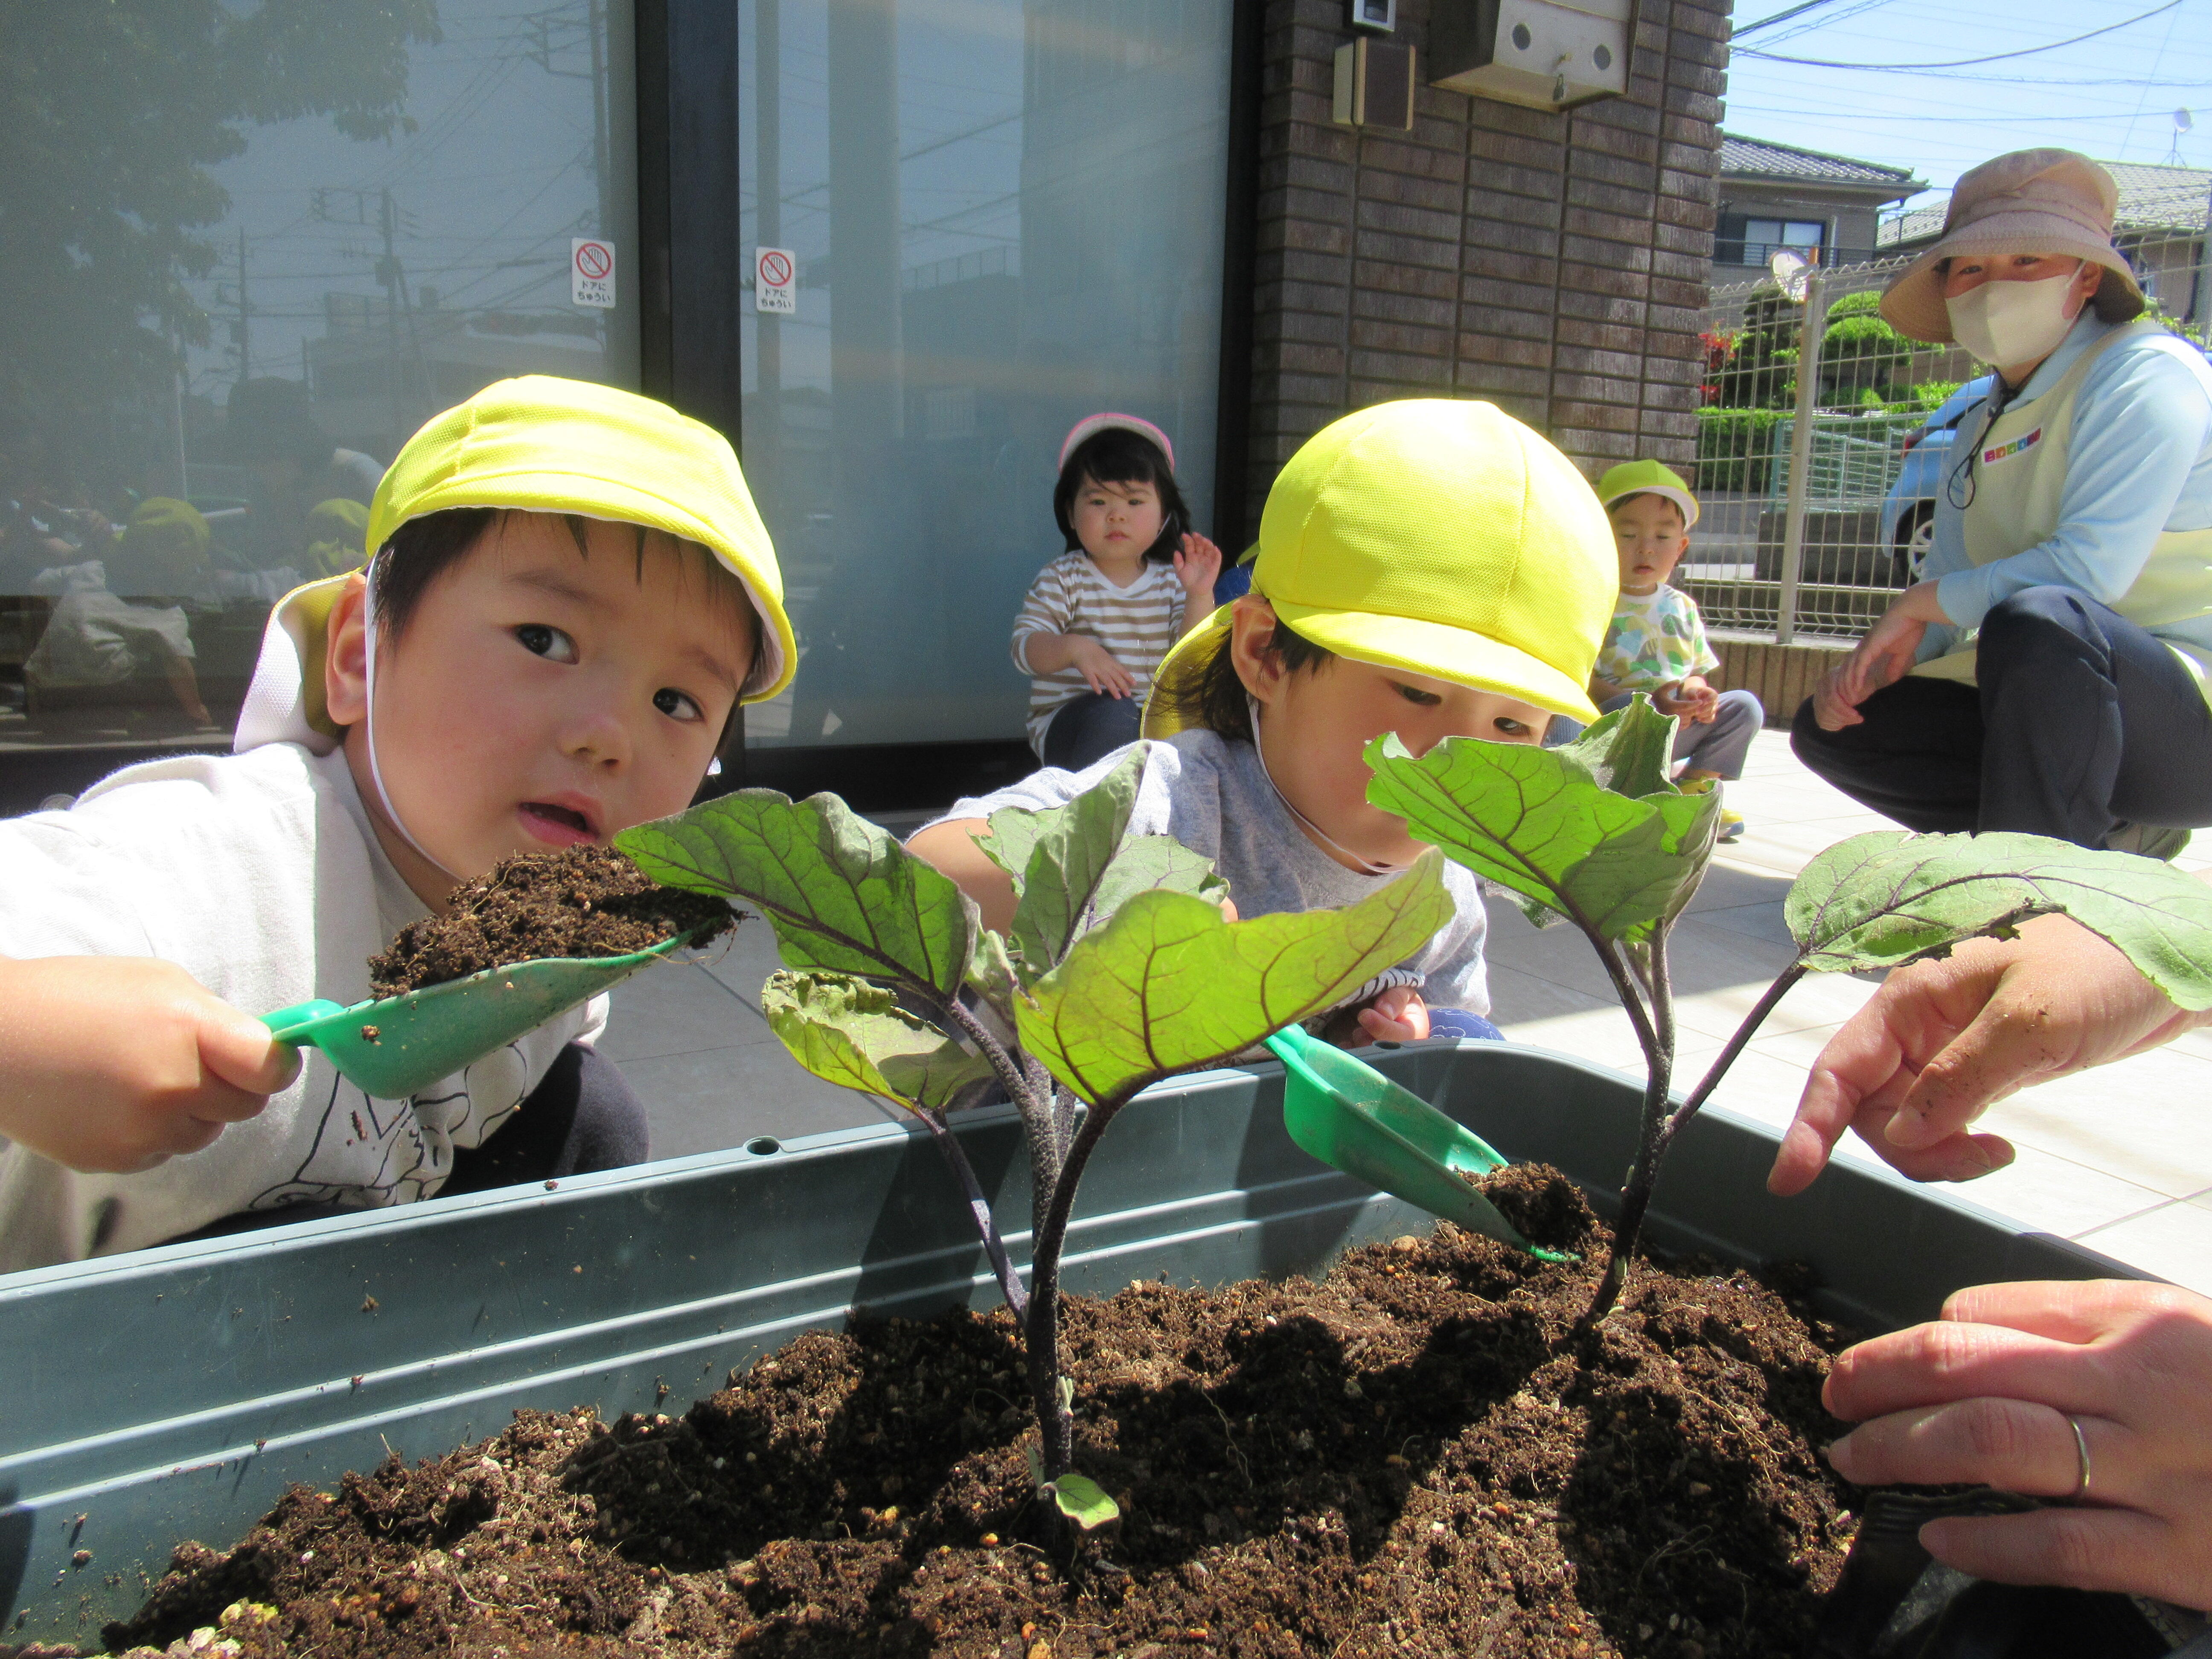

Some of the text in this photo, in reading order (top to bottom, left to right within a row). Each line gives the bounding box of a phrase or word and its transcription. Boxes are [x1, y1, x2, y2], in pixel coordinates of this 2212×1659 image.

[582, 280, 606, 291] ドアに
[577, 291, 611, 302] ちゅうい
[765, 287, 787, 298] ドアに
